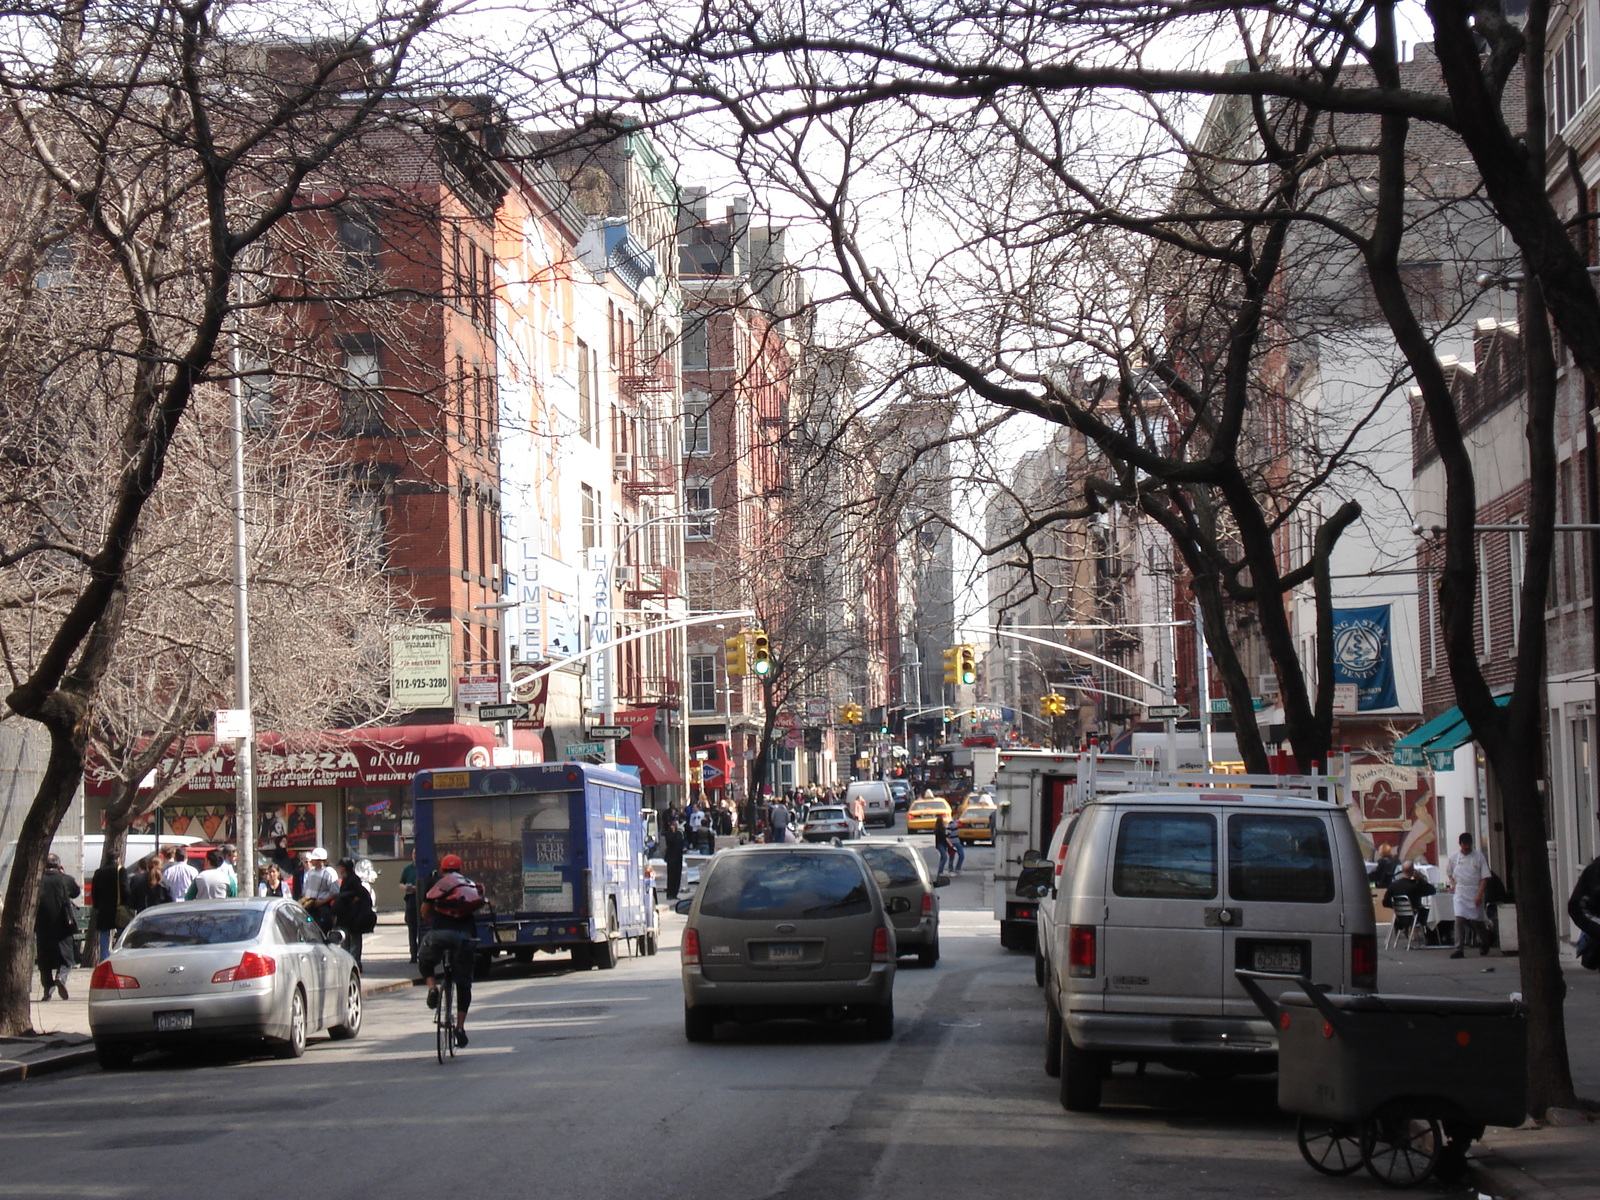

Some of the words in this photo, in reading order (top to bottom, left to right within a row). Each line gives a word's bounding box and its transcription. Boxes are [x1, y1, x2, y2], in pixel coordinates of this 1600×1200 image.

[1340, 666, 1378, 679] DENTAL
[395, 678, 447, 689] 212-925-3280
[483, 709, 497, 717] ONE
[567, 744, 598, 755] THOMPSON
[261, 752, 360, 770] PIZZA
[389, 752, 420, 766] SoHo
[366, 773, 377, 781] WE
[378, 772, 406, 781] DELIVER
[188, 782, 210, 790] HOME
[214, 782, 236, 790] MADE
[272, 779, 289, 787] ICES
[313, 778, 337, 786] HEROS
[536, 842, 564, 852] DEER
[536, 851, 565, 862] PARK
